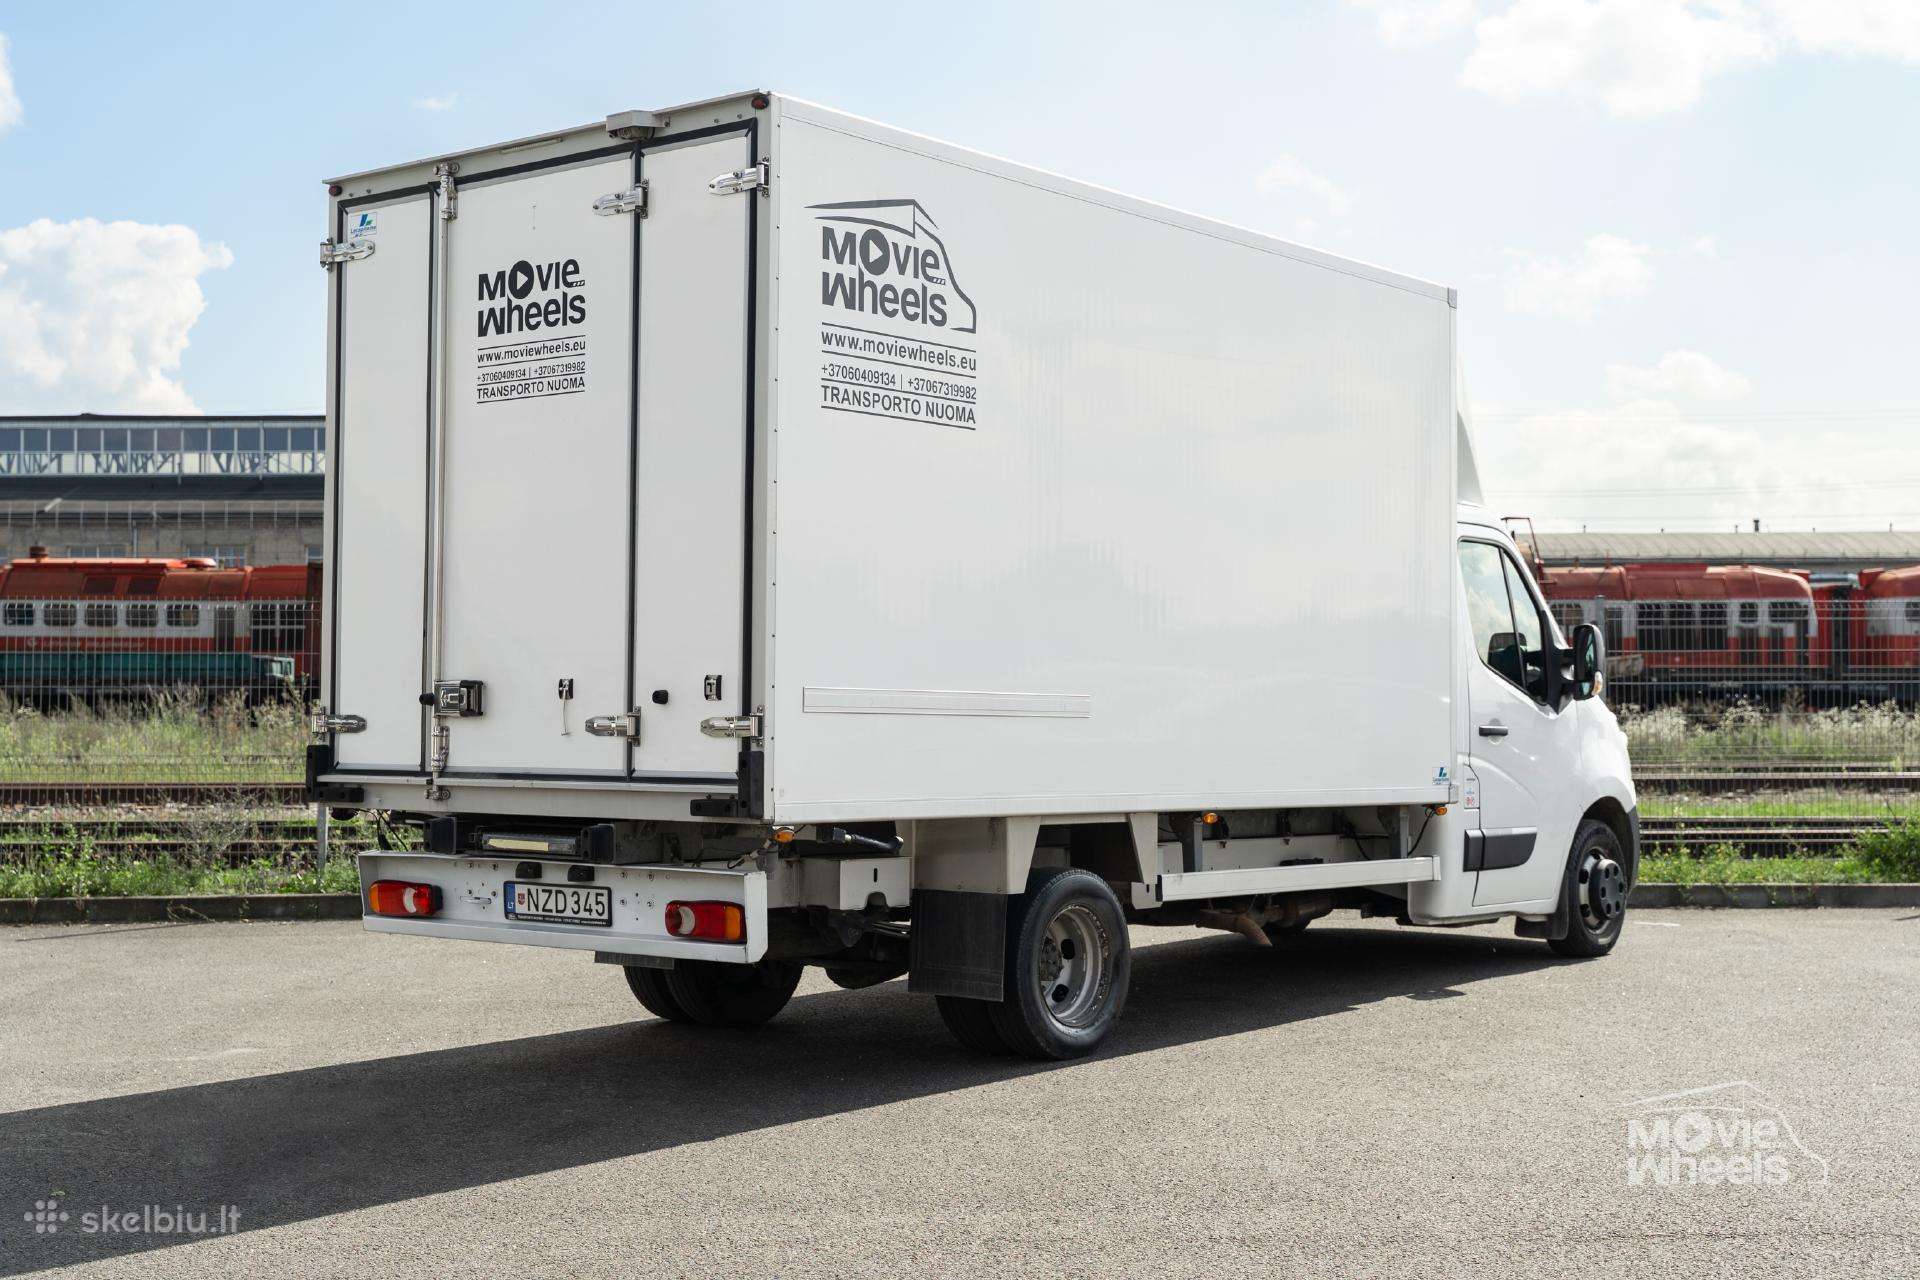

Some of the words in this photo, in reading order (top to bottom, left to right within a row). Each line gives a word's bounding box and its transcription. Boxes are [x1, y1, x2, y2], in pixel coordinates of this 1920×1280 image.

[477, 291, 586, 338] Wheels
[822, 265, 948, 327] Wheels
[477, 340, 586, 363] www.moviewheels.eu
[821, 330, 977, 371] www.moviewheels.eu
[477, 381, 545, 400] TRANSPORTO
[547, 377, 586, 392] NUOMA
[821, 363, 897, 387] +37060409134
[907, 377, 977, 400] +37067319982
[821, 385, 922, 416] TRANSPORTO
[925, 401, 977, 424] NUOMA
